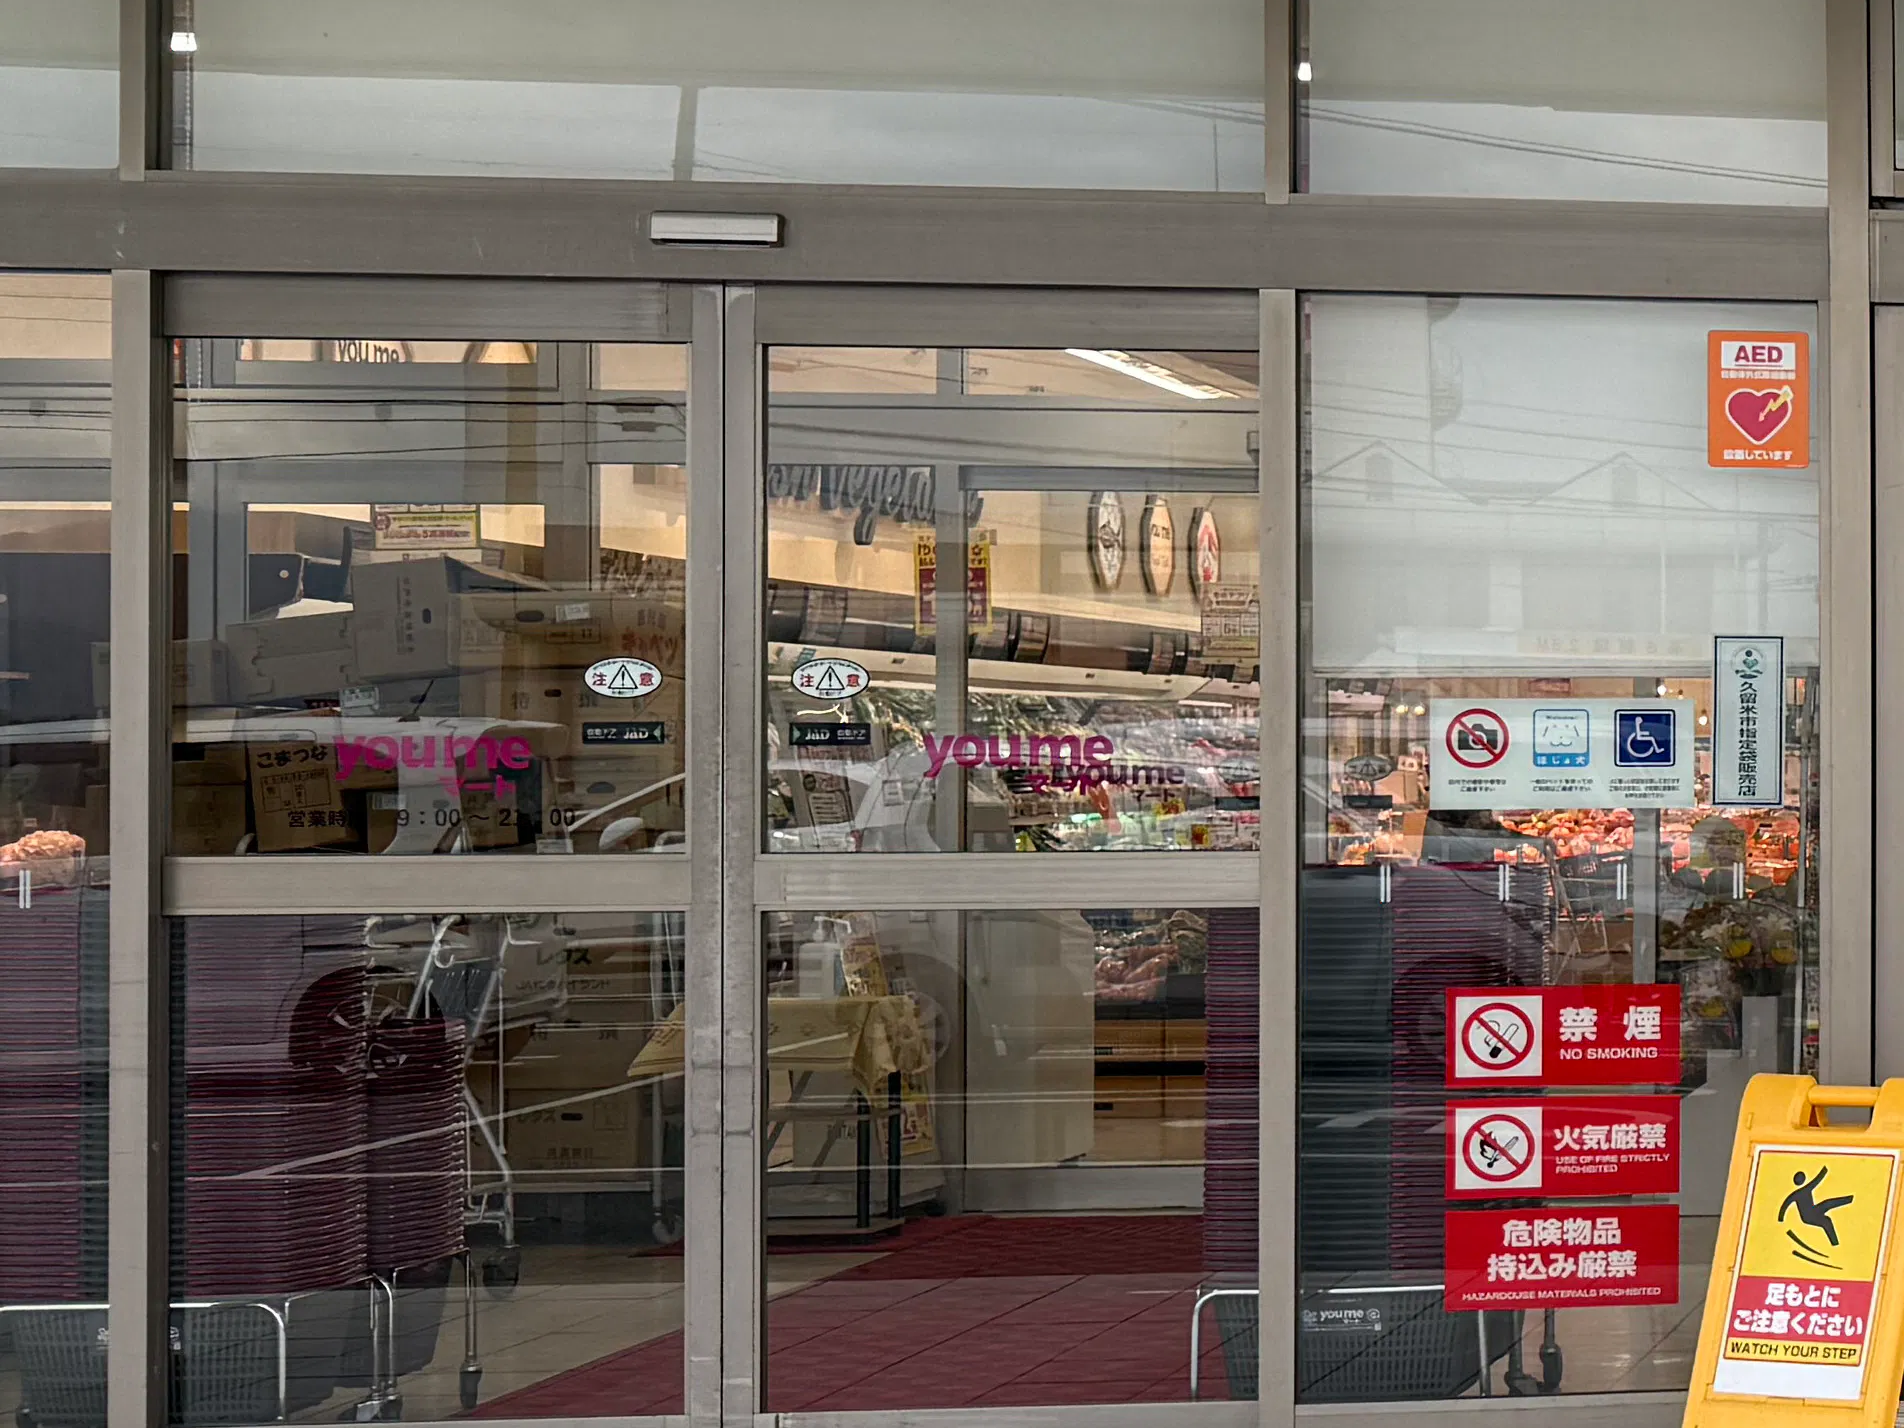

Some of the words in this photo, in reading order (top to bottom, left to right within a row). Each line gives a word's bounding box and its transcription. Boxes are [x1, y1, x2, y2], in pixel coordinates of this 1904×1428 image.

[1735, 345, 1783, 363] AED
[257, 745, 328, 768] こまつな
[924, 732, 1114, 777] youme
[1559, 1005, 1662, 1042] 禁煙
[1560, 1048, 1583, 1060] NO
[1587, 1046, 1659, 1060] SMOKING
[1553, 1123, 1667, 1152] 火気厳禁
[1555, 1164, 1619, 1174] PROHIBITED
[1556, 1155, 1578, 1165] USE
[1620, 1153, 1671, 1163] STRICTLY
[1502, 1217, 1622, 1247] 危険物品
[1487, 1250, 1637, 1283] 持込み厳禁
[1538, 1289, 1597, 1300] MATERIALS
[1599, 1287, 1662, 1298] PROHIBITED
[1764, 1282, 1841, 1308] 足もとに
[1733, 1308, 1863, 1337] ご注意ください
[1731, 1341, 1778, 1355] WATCH
[1783, 1345, 1819, 1358] YOUR
[1822, 1347, 1857, 1360] STEP
